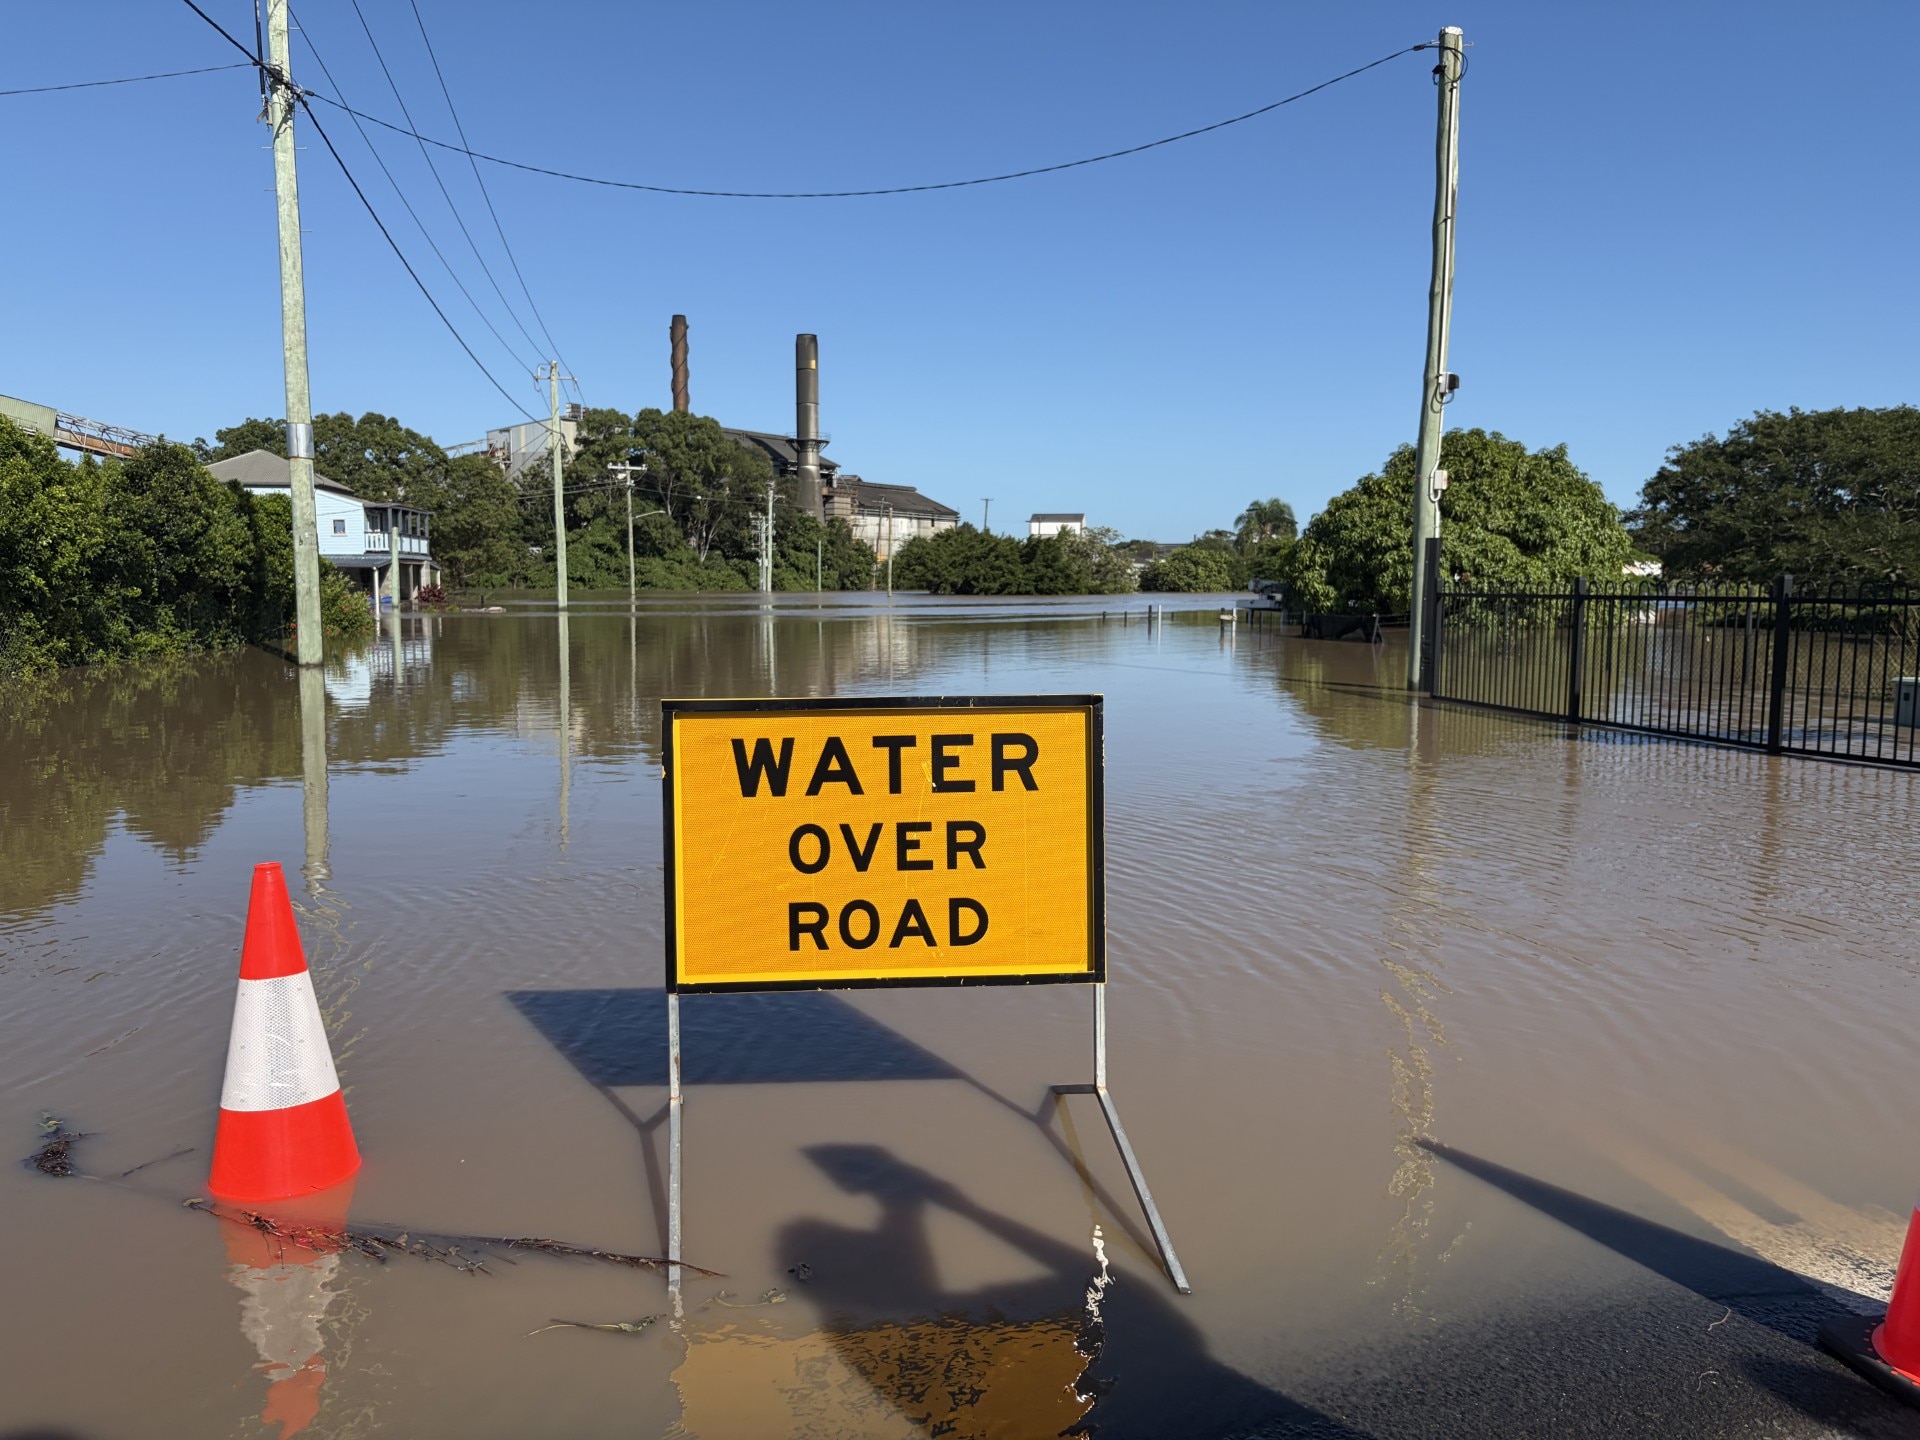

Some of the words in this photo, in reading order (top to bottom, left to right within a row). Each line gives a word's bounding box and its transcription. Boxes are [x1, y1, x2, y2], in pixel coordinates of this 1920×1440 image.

[731, 733, 1039, 797] WATER
[789, 821, 986, 874] OVER
[789, 898, 988, 951] ROAD
